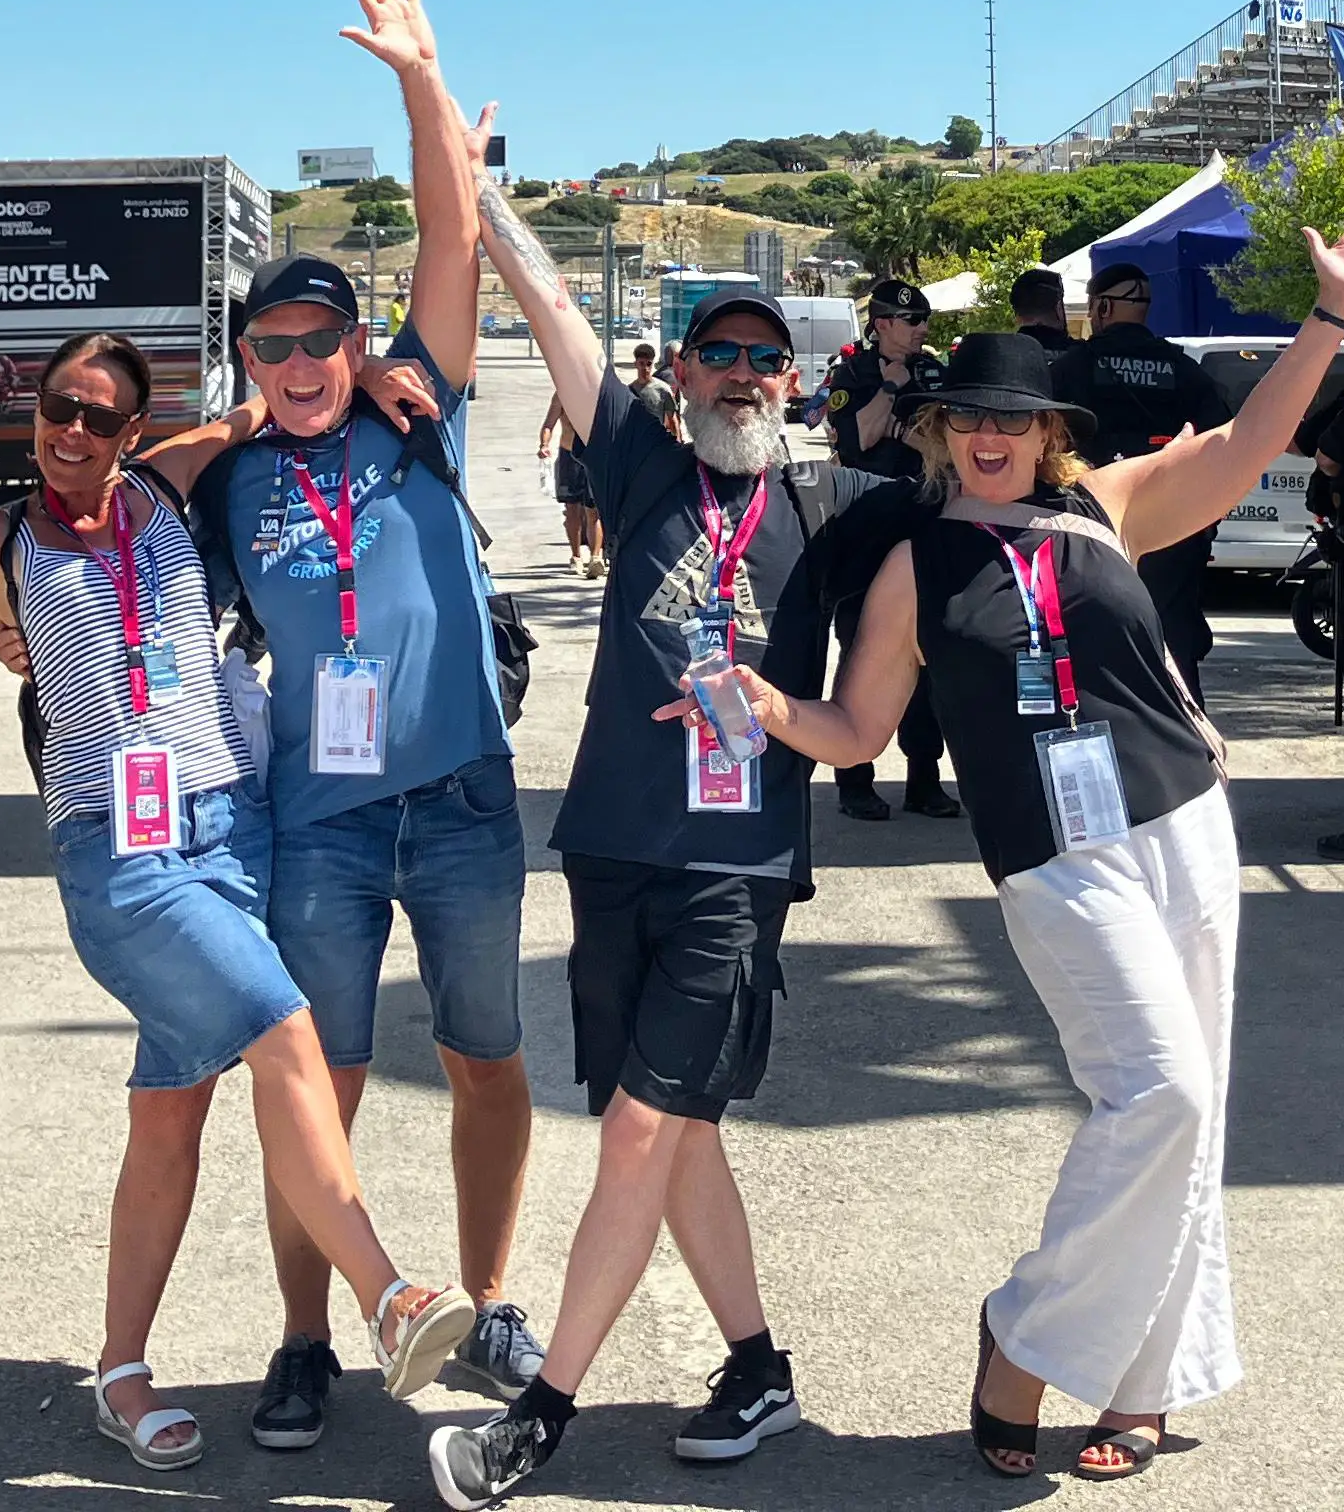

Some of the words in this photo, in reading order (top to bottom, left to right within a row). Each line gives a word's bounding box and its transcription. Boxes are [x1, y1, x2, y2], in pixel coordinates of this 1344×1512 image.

[1280, 7, 1303, 22] W6
[124, 208, 132, 219] 6
[151, 207, 189, 218] JUNIO
[73, 263, 110, 282] LA
[1272, 475, 1305, 488] 4986
[260, 518, 279, 532] VA
[351, 517, 381, 560] PRIX
[699, 630, 723, 645] VA
